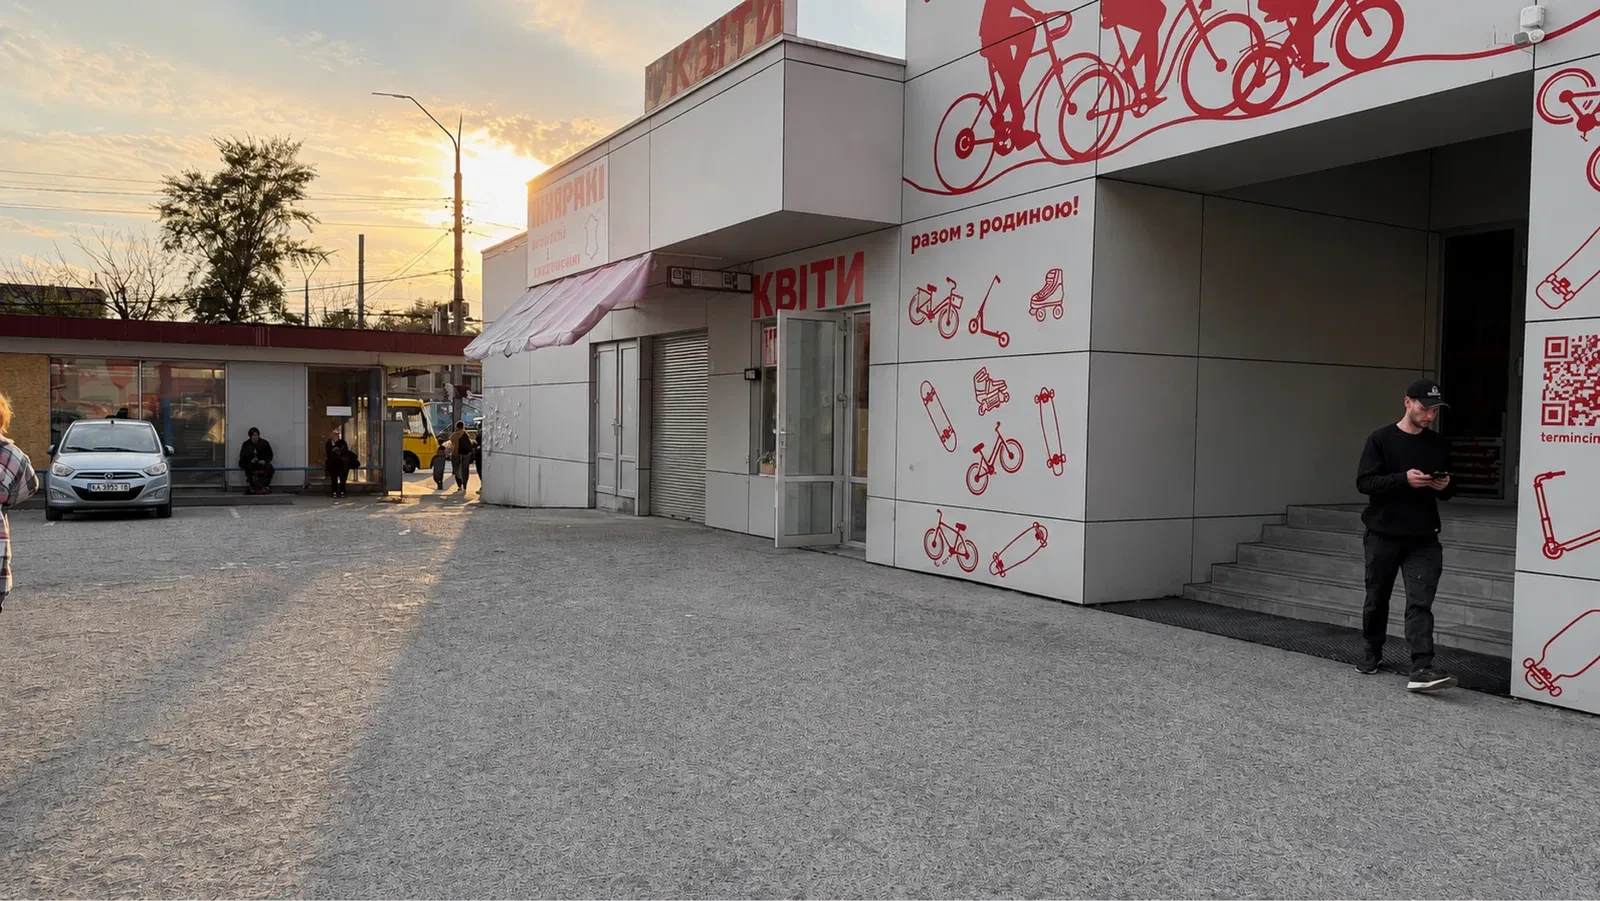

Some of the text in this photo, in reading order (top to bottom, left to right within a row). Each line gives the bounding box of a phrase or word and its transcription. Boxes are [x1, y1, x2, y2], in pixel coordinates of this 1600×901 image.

[911, 195, 1080, 254] разом з родиною!
[752, 250, 865, 320] КВІТИ
